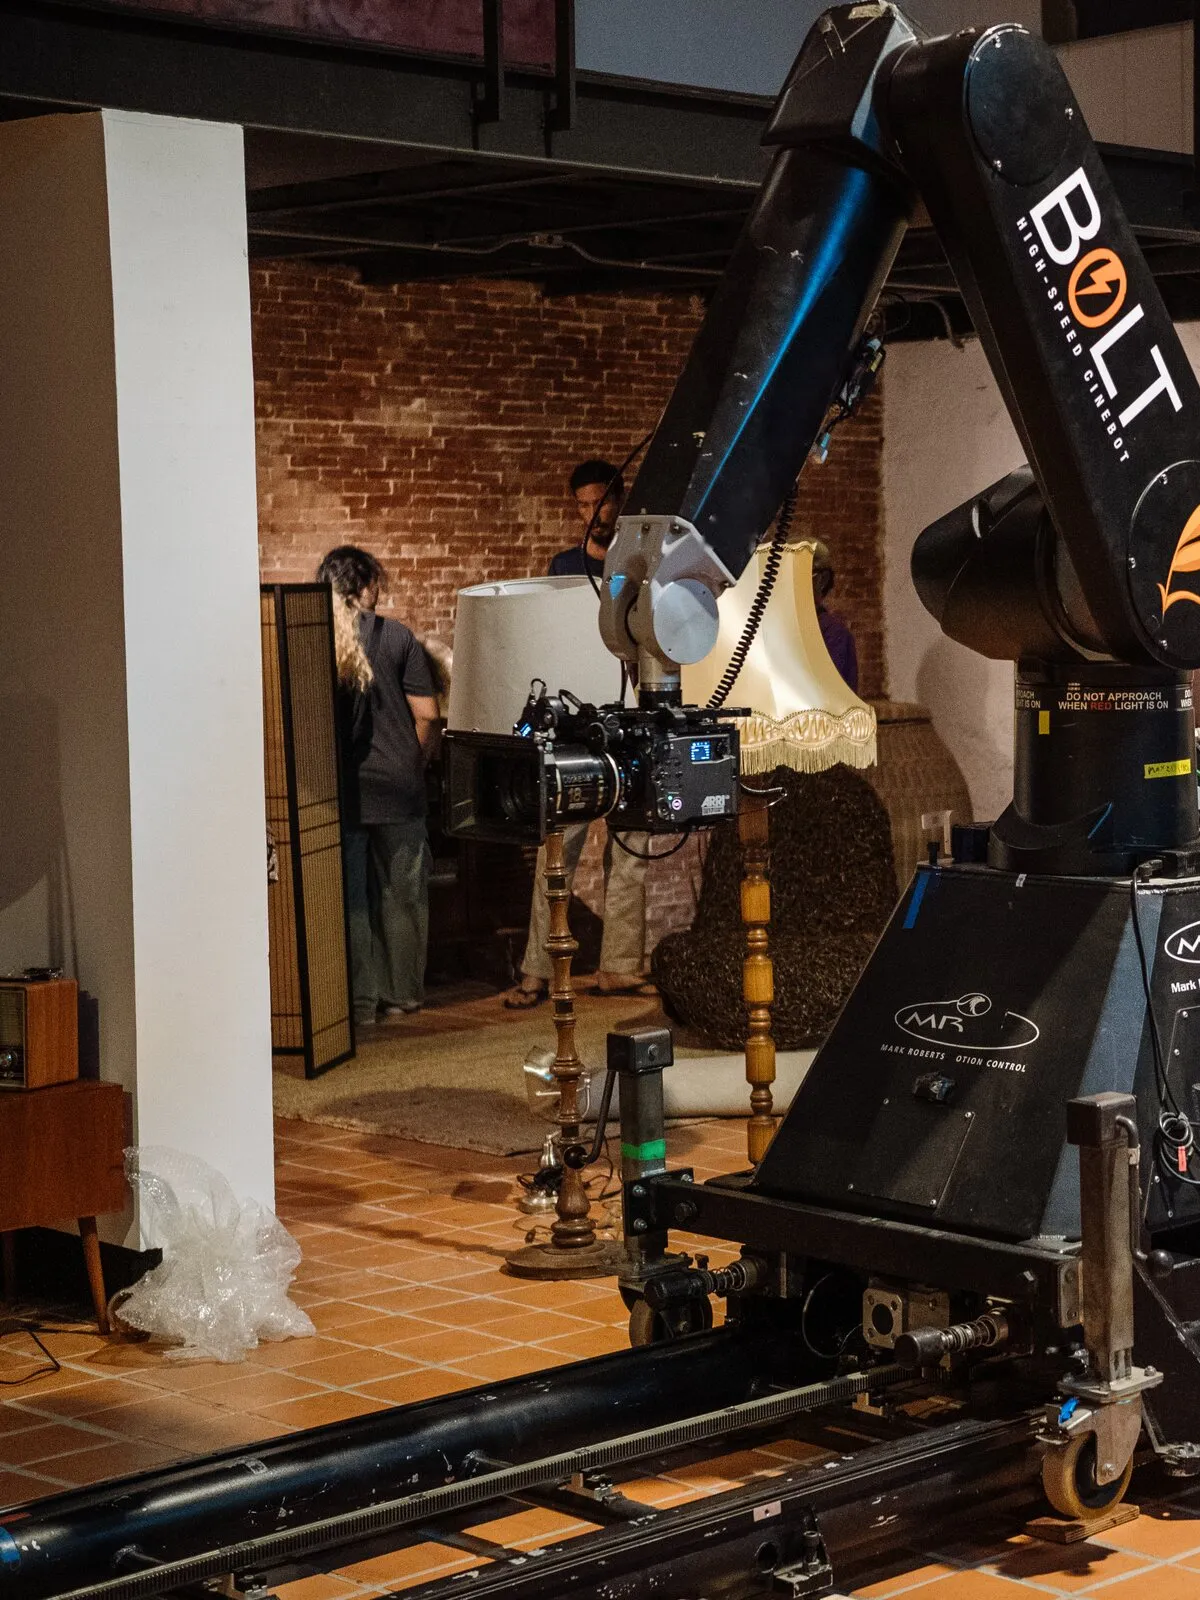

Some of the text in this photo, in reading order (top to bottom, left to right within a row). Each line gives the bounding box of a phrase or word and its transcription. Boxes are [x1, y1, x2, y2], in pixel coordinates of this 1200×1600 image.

[1029, 166, 1183, 428] BOLT
[1016, 216, 1130, 463] HIGH-SPEED CINEBOT
[1066, 692, 1162, 701] DO NOT APPROACH
[1030, 700, 1041, 709] ON
[1058, 700, 1169, 711] WHEN RED LIGHT IS ON
[1171, 981, 1197, 994] Mark
[880, 1043, 904, 1054] MARK
[907, 1047, 946, 1061] ROBERTS
[986, 1059, 1027, 1073] CONTROL
